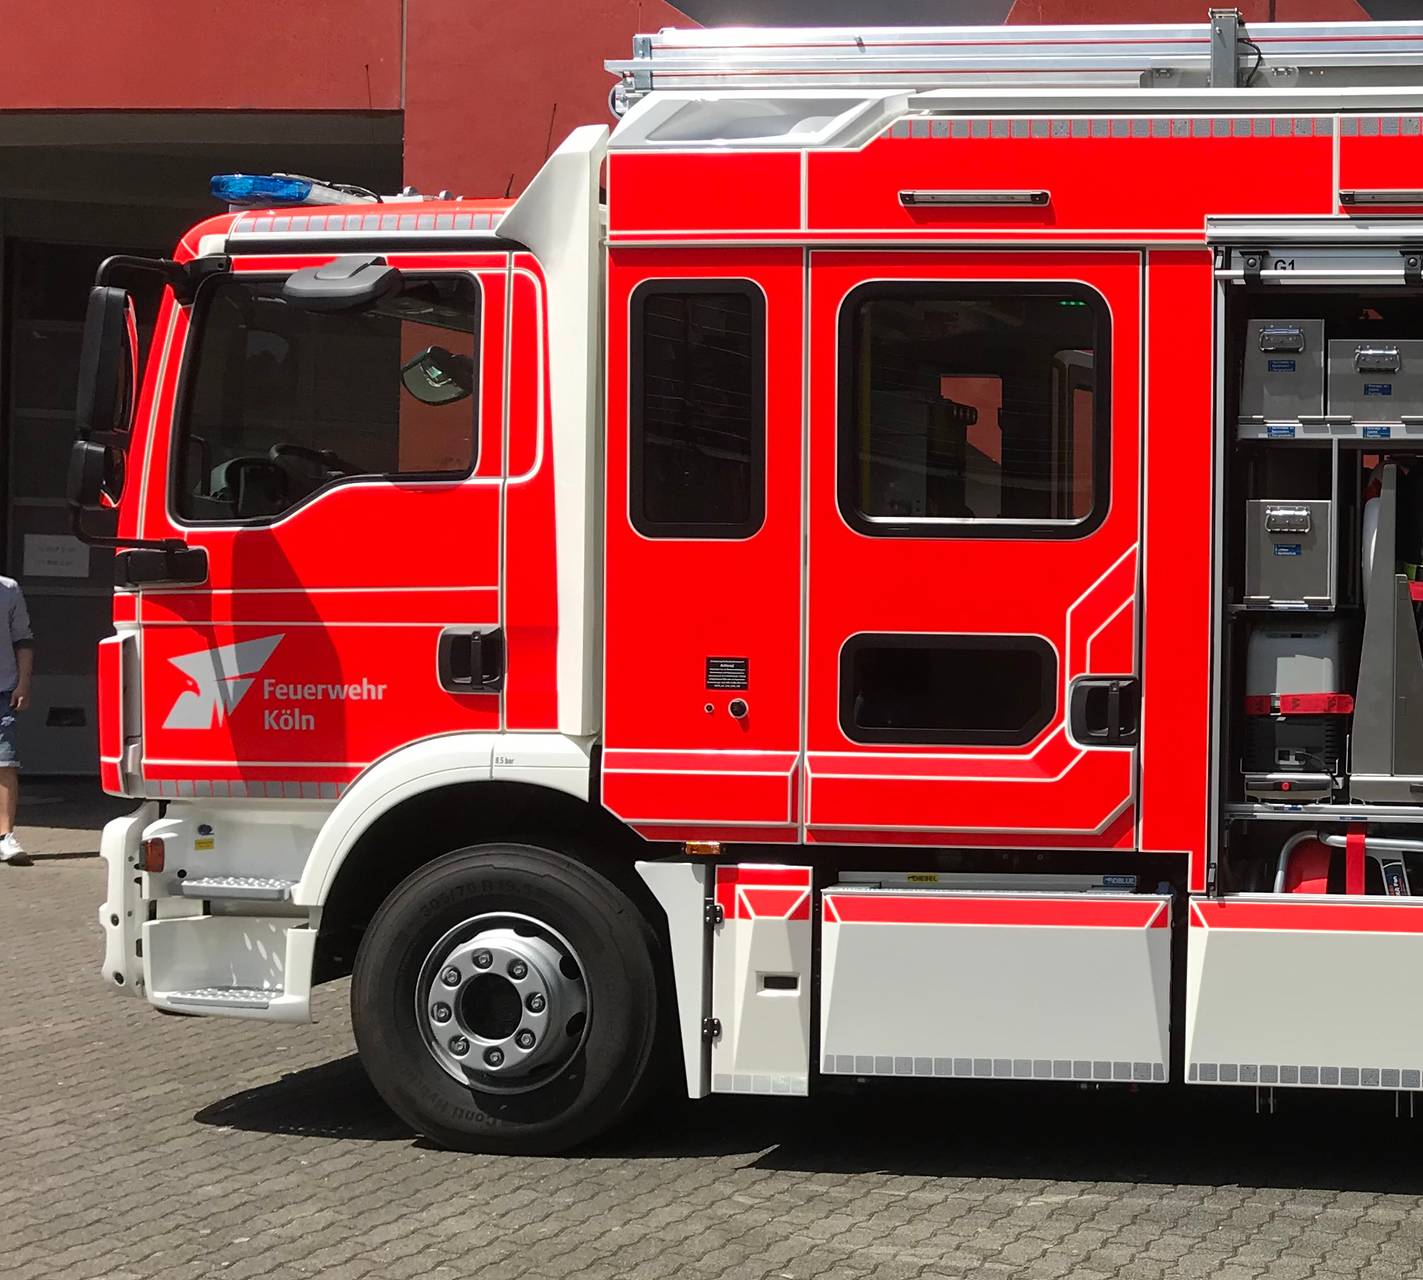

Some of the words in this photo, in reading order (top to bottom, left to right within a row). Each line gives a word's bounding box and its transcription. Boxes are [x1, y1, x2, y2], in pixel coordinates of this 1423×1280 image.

[1274, 258, 1295, 271] G1
[263, 678, 388, 700] Feuerwehr
[264, 708, 315, 730] Köln
